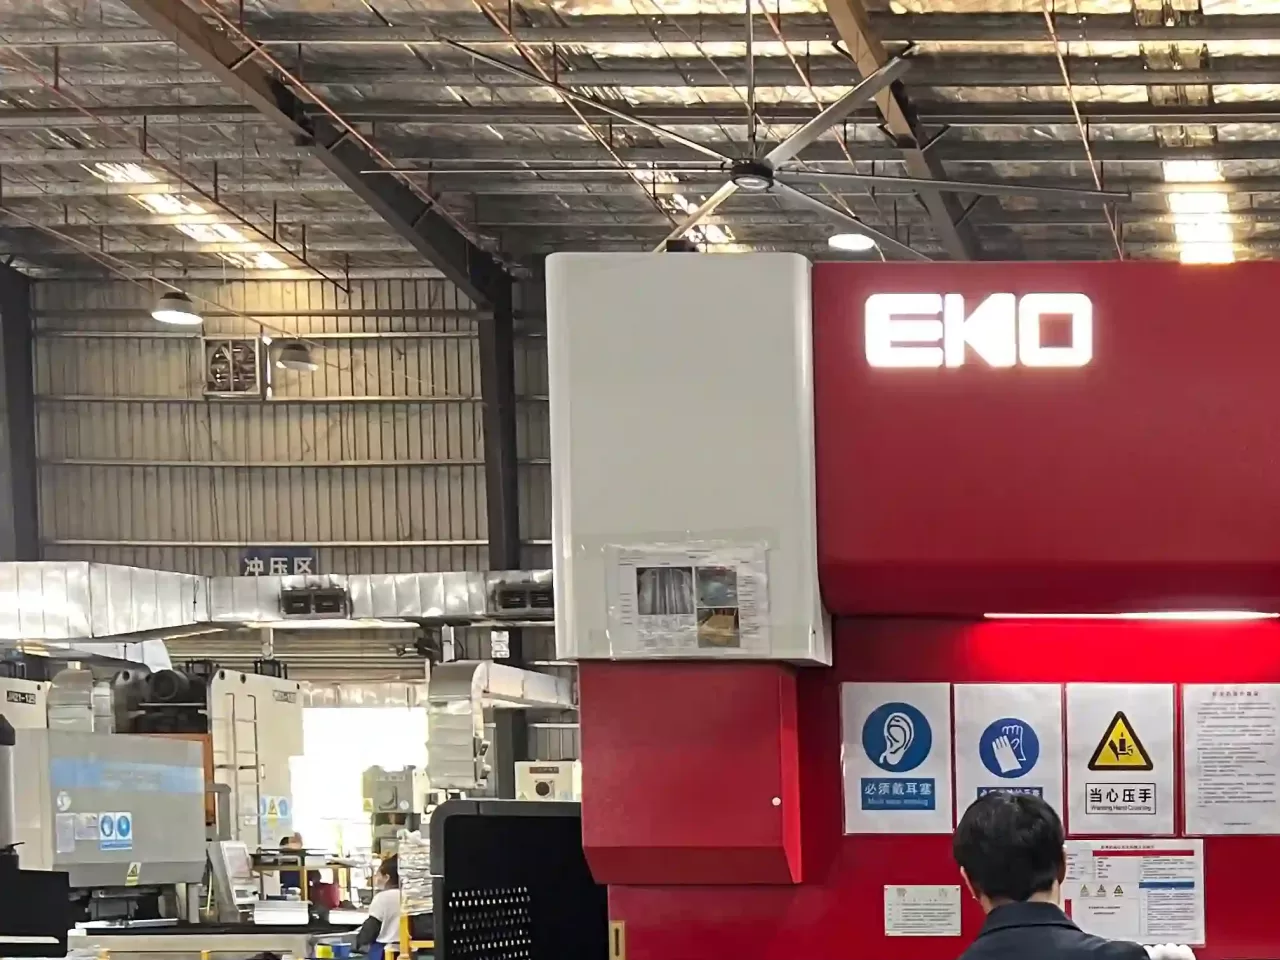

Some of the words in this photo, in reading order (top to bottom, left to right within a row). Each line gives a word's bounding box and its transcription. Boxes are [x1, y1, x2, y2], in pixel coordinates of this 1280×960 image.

[865, 293, 1093, 368] EKO
[244, 556, 313, 576] 冲压区
[1090, 787, 1152, 803] 当心压手
